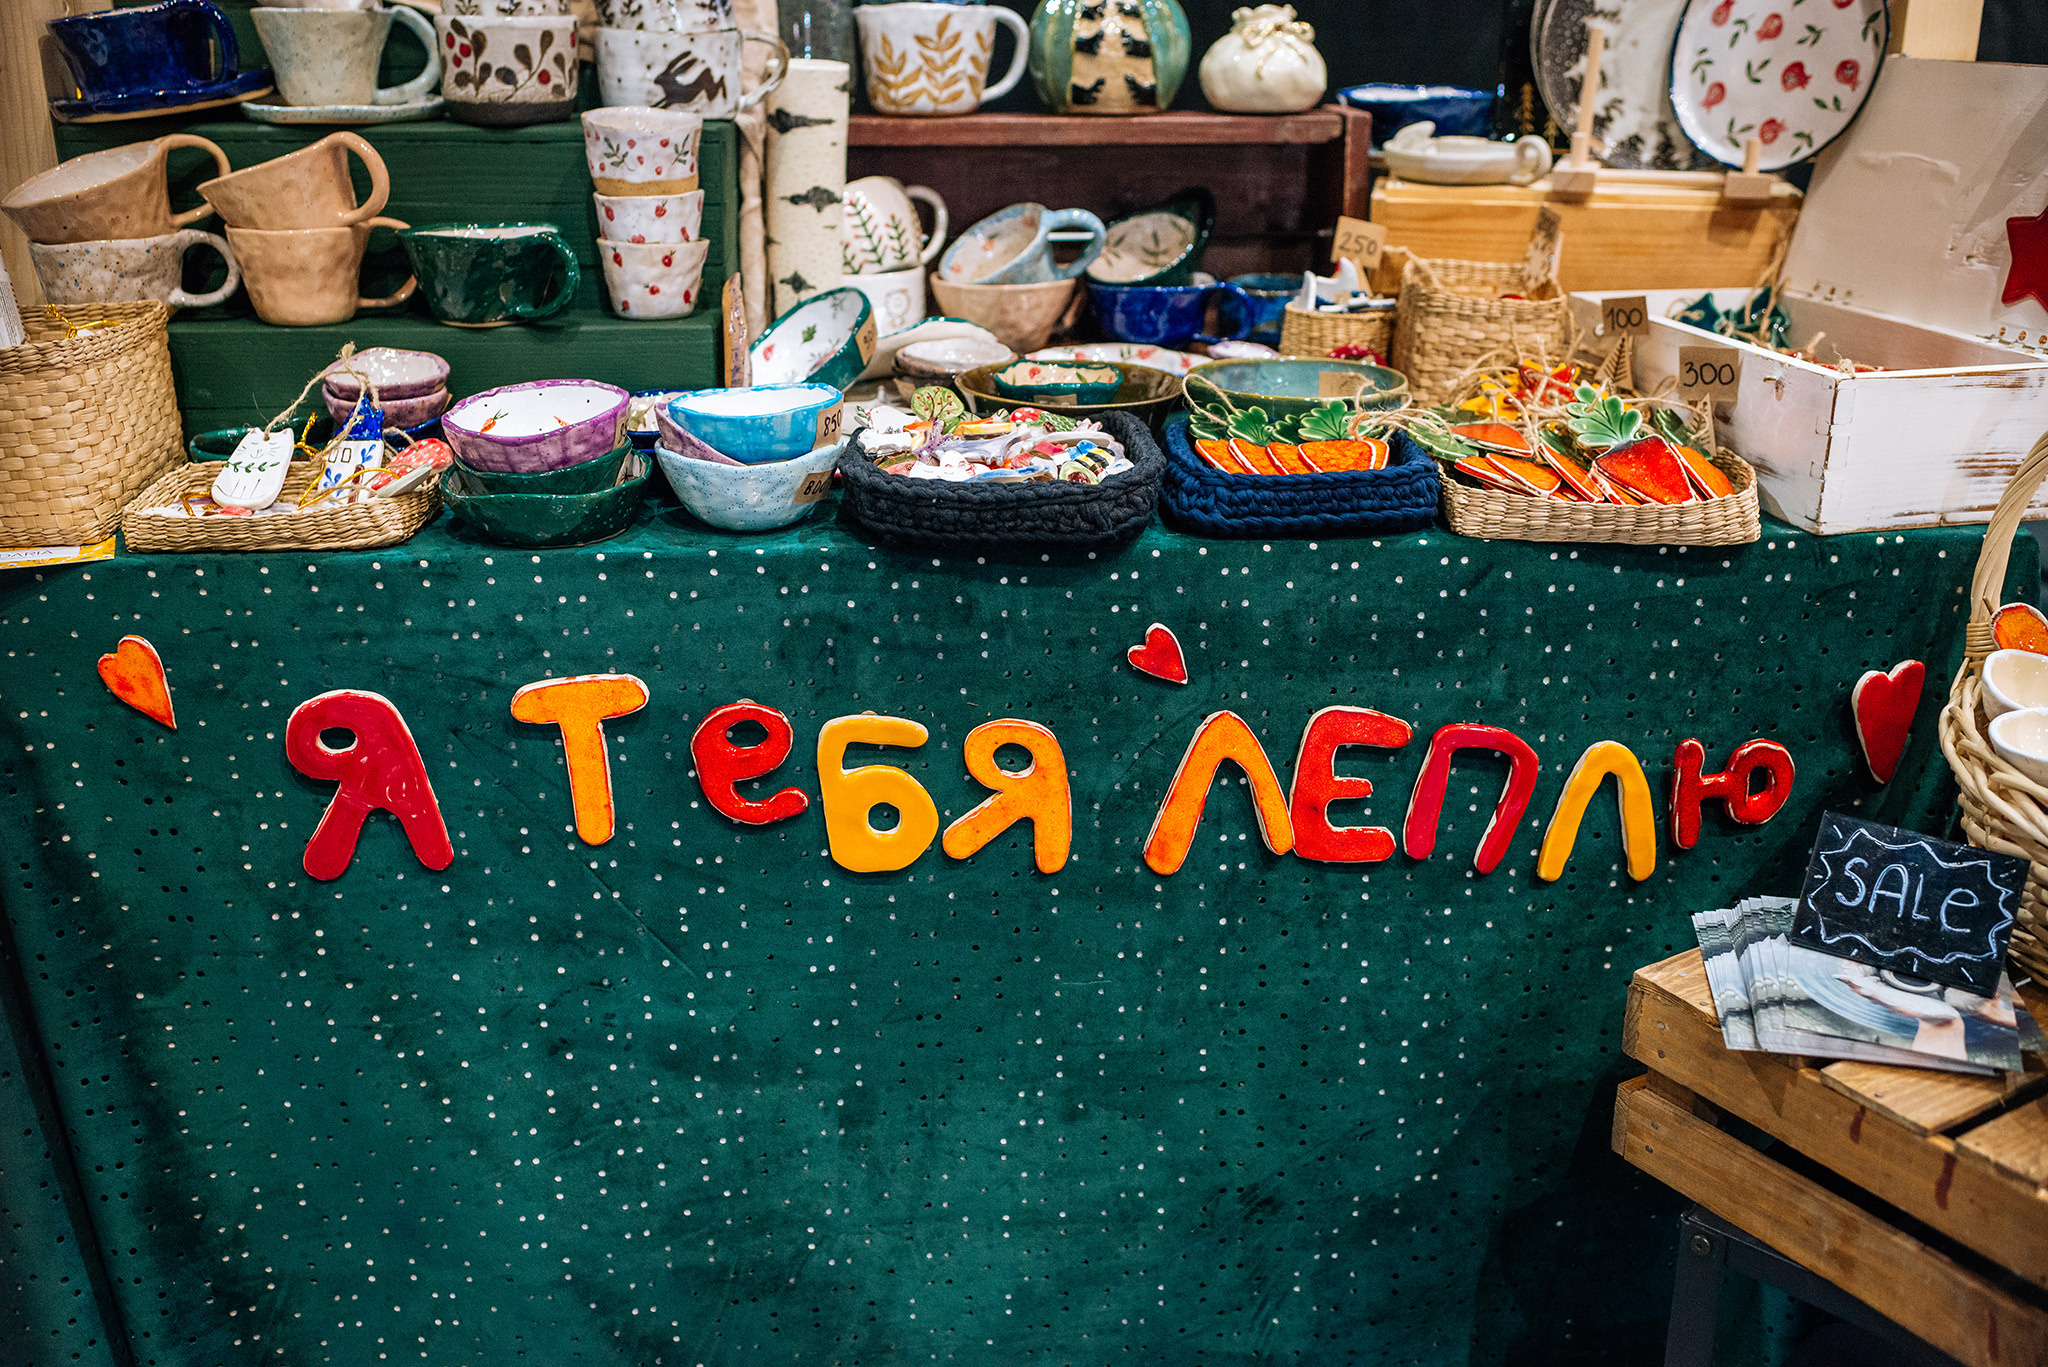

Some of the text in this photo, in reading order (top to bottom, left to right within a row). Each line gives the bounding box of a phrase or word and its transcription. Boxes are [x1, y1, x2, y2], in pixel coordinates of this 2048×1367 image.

[1338, 231, 1378, 256] 250
[1604, 307, 1643, 332] 100
[1683, 361, 1735, 387] 300
[823, 409, 842, 437] 850
[286, 689, 454, 881] Я
